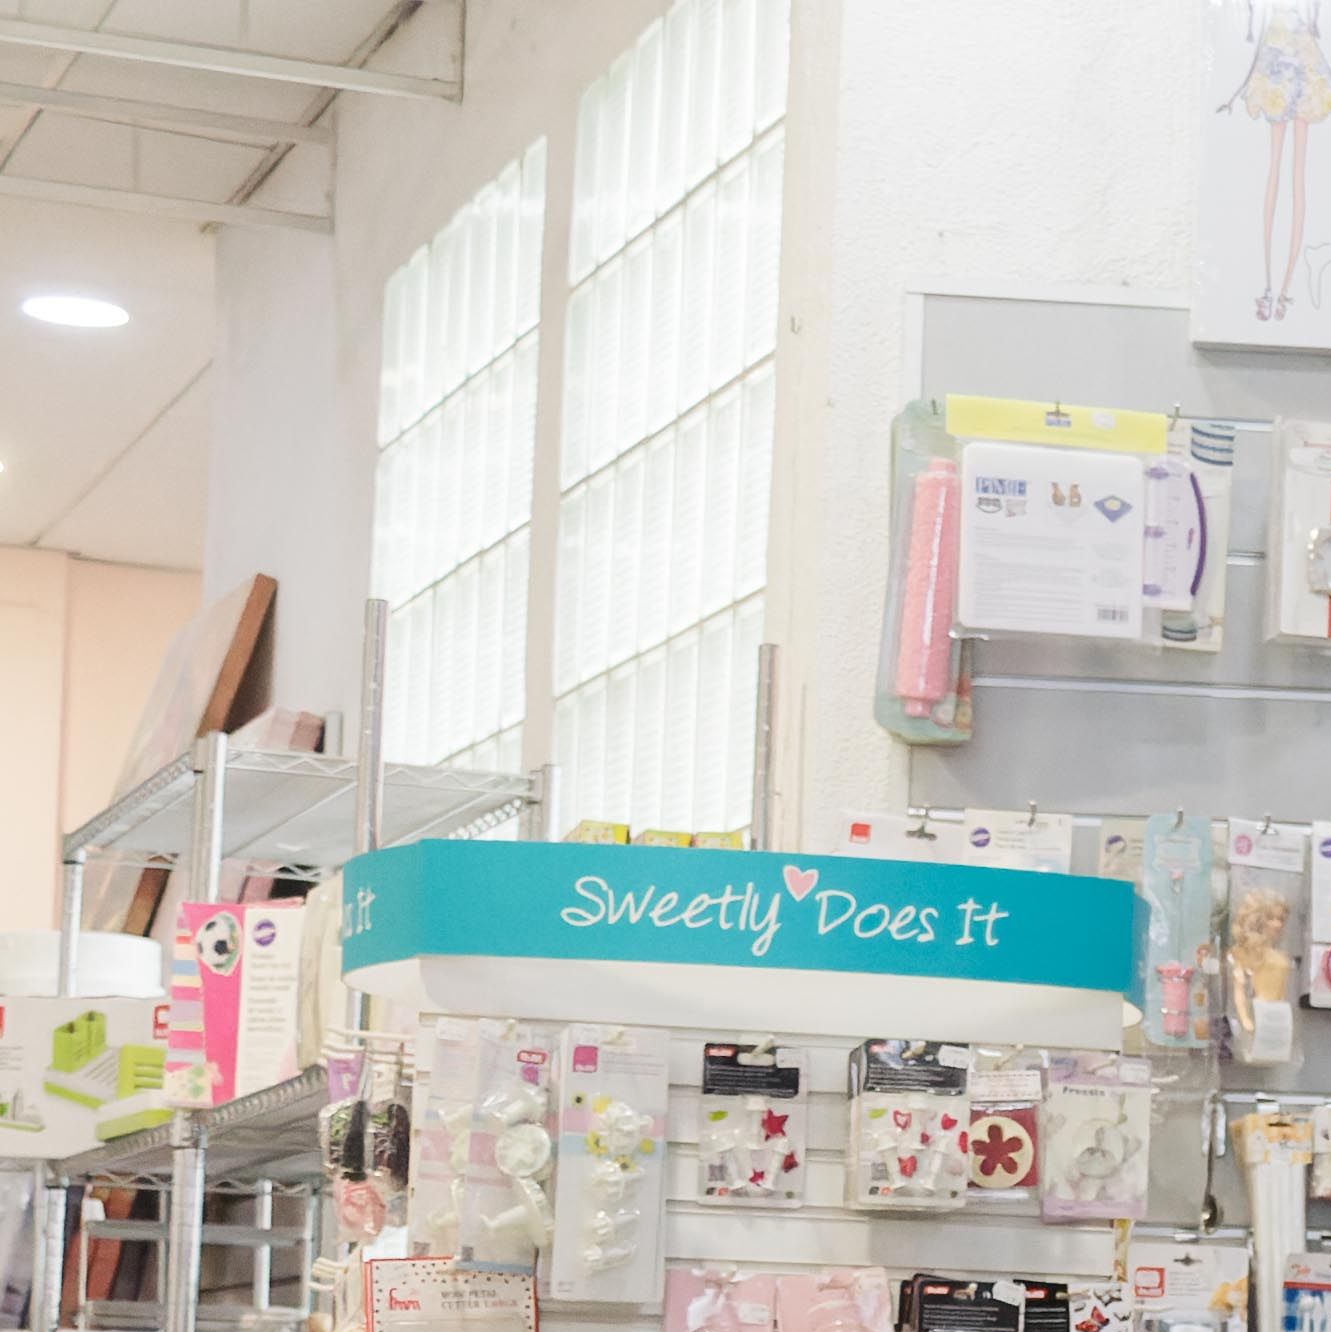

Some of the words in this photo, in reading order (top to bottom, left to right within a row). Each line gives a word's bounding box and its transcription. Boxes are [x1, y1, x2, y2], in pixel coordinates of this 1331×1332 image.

[560, 875, 783, 957] Sweetly
[815, 889, 939, 943] Does
[955, 896, 1010, 947] It
